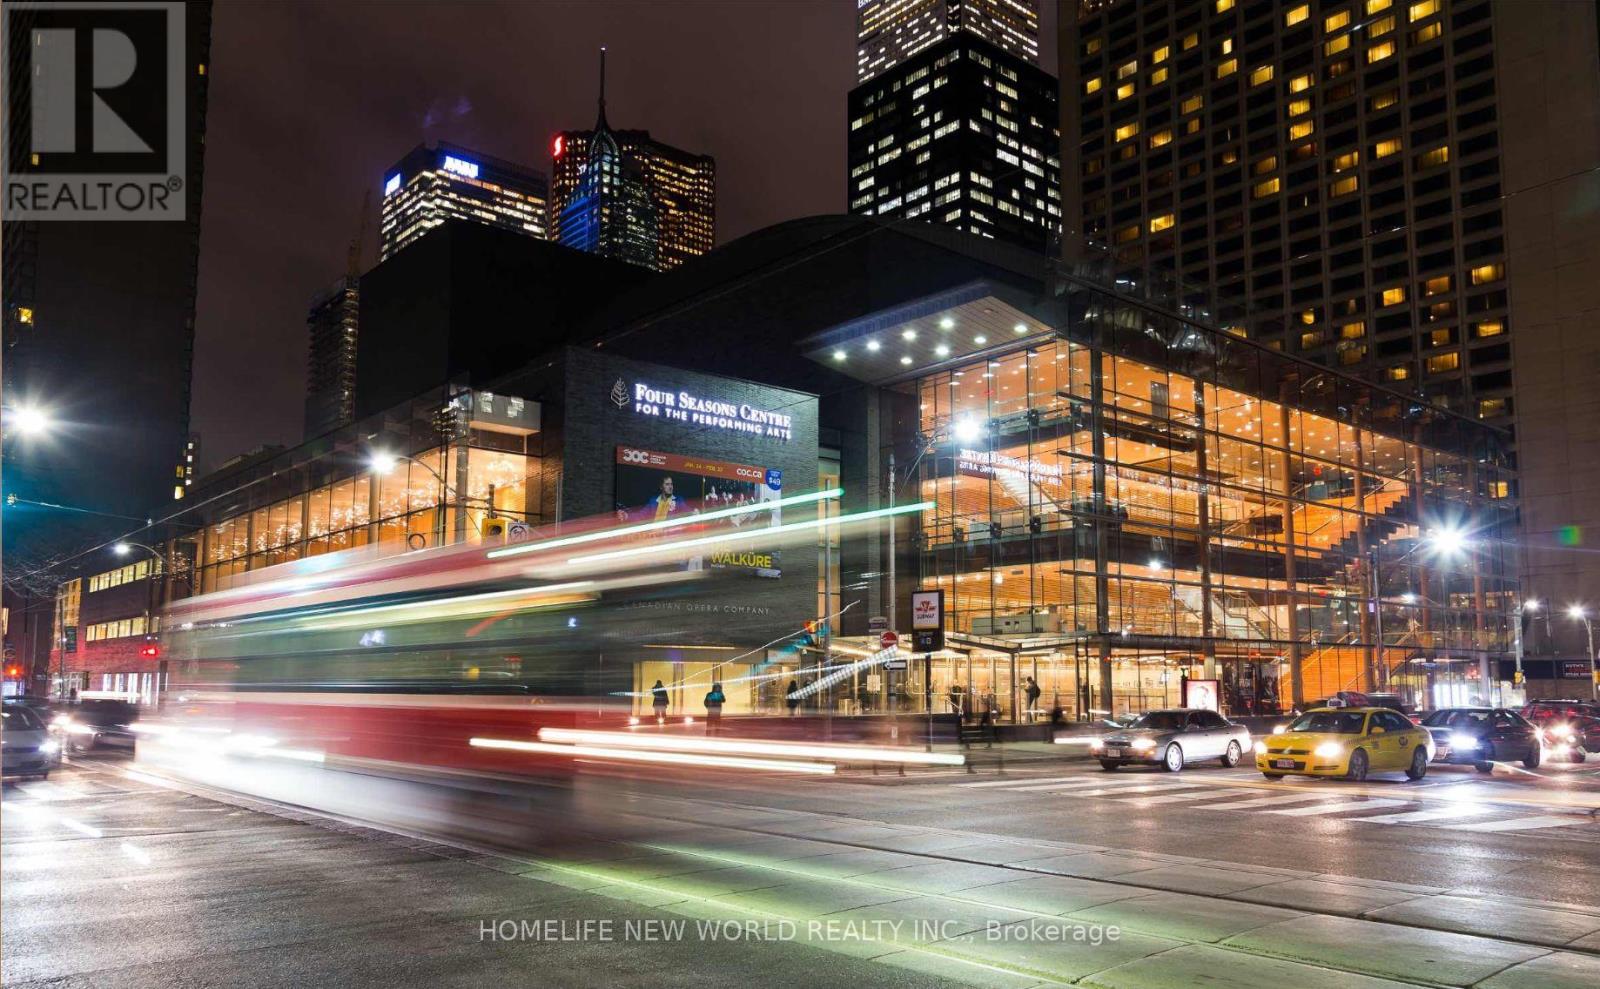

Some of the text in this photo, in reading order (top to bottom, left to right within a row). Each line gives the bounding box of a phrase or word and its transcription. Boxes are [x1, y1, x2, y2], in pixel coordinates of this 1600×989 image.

[635, 383, 792, 428] FOUR SEASONS CENTRE
[635, 402, 792, 440] FOR THE PERFORMING ARTS
[711, 551, 772, 568] WALKÜRE
[723, 605, 770, 615] COMPANY
